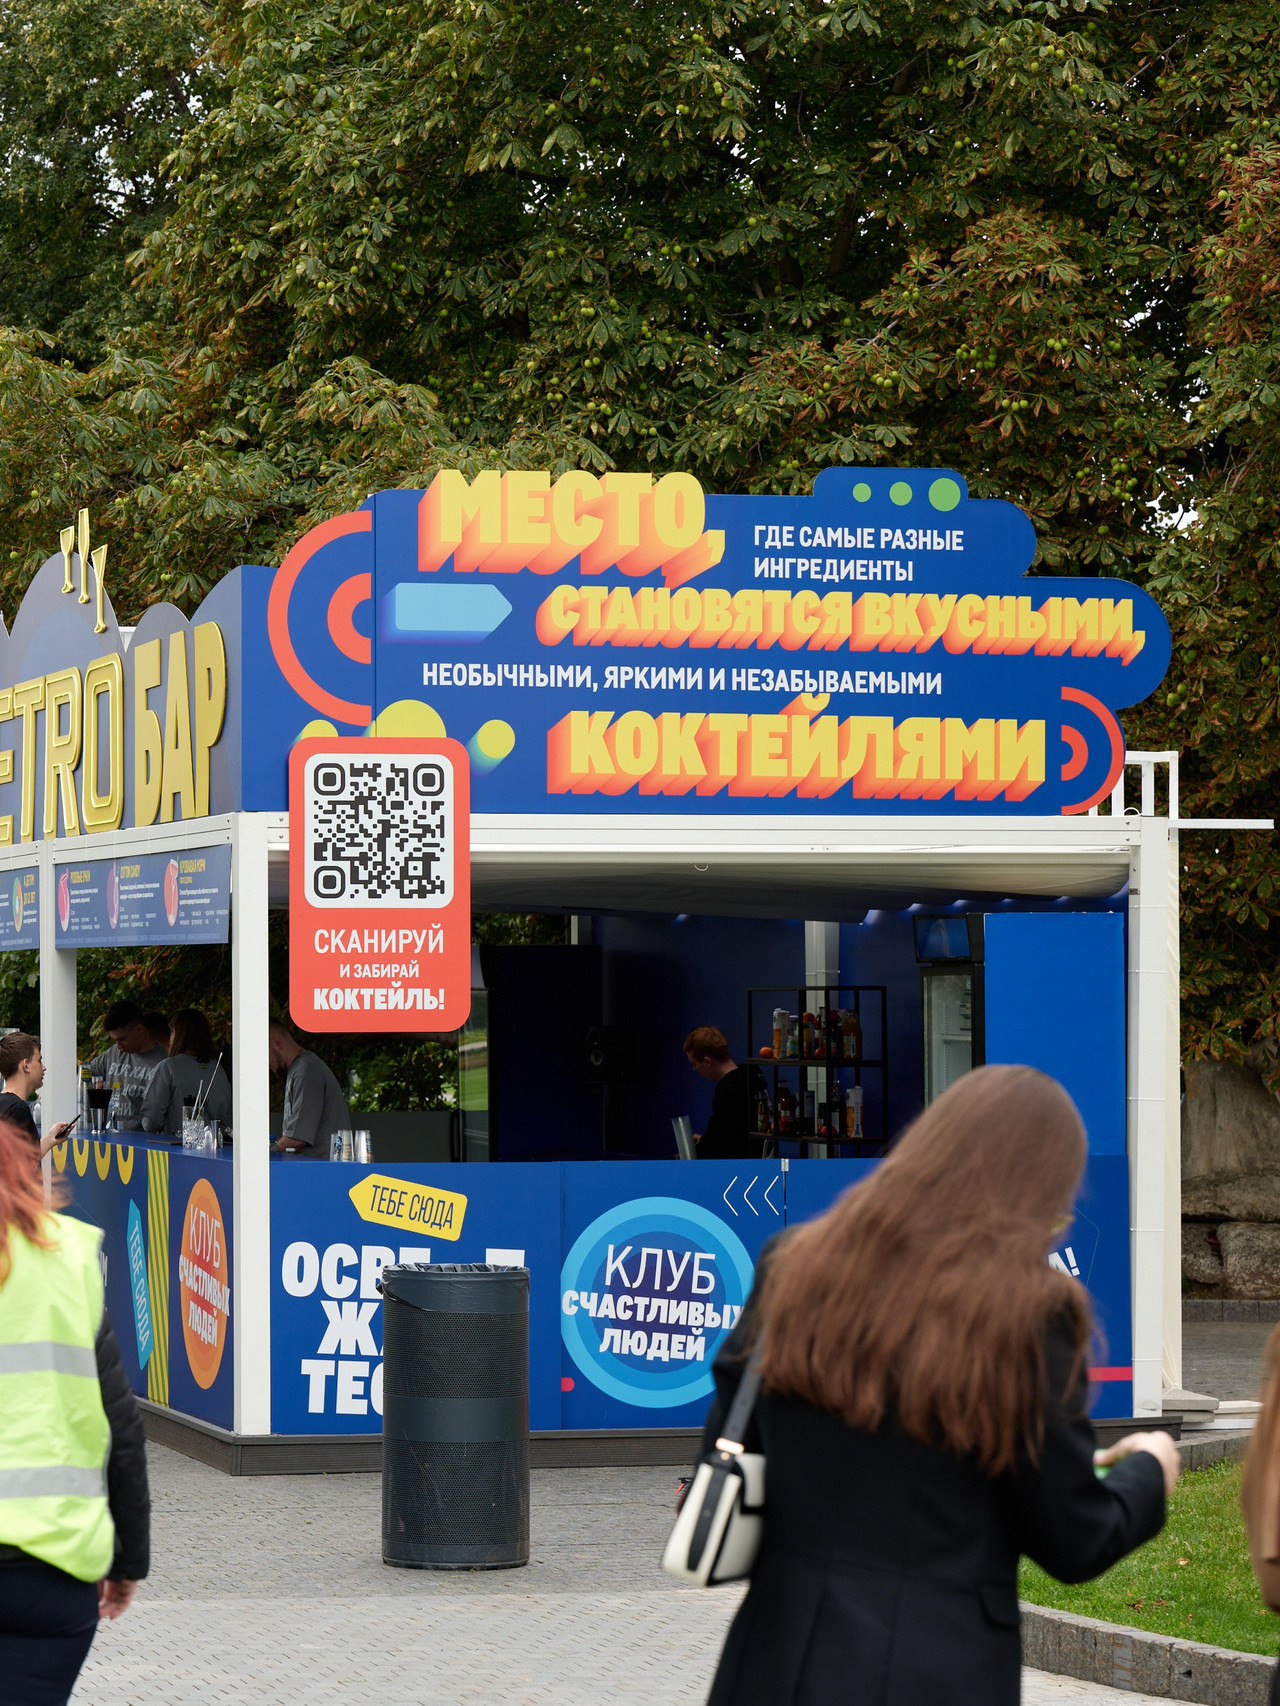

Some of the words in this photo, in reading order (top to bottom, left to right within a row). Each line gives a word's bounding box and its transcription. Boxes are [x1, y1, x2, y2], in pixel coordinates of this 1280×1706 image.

[435, 468, 726, 566] МЕСТО,
[754, 525, 794, 550] ГДЕ
[799, 526, 875, 550] САМЫЕ
[880, 527, 964, 551] РАЗНЫЕ
[754, 557, 913, 582] ИНГРЕДИЕНТЫ
[548, 584, 852, 637] СТАНОВЯТСЯ
[862, 591, 1146, 664] ВКУСНЫМИ,
[423, 662, 598, 694] НЕОБЫЧНЫМИ,
[603, 666, 702, 691] ЯРКИМИ
[709, 667, 725, 691] И
[730, 668, 942, 696] НЕЗАБЫВАЕМЫМИ
[135, 621, 226, 828] БАР
[568, 692, 1046, 782] КОКТЕЙЛЯМИ
[314, 922, 444, 954] СКАНИРУЙ
[339, 964, 350, 978] И
[354, 960, 420, 979] ЗАБИРАЙ
[313, 982, 445, 1011] КОКТЕЙЛЬ!
[370, 1184, 408, 1219] ТЕБЕ
[408, 1193, 455, 1231] СЮДА
[130, 1220, 143, 1284] ТЕБЕ
[189, 1204, 221, 1270] КЛУБ
[178, 1254, 230, 1317] СЧАСТЛИВЫХ
[604, 1243, 716, 1295] КЛУБ
[135, 1277, 151, 1352] СЮДА
[188, 1300, 218, 1348] ЛЮДЕЙ
[599, 1327, 706, 1362] ЛЮДЕЙ
